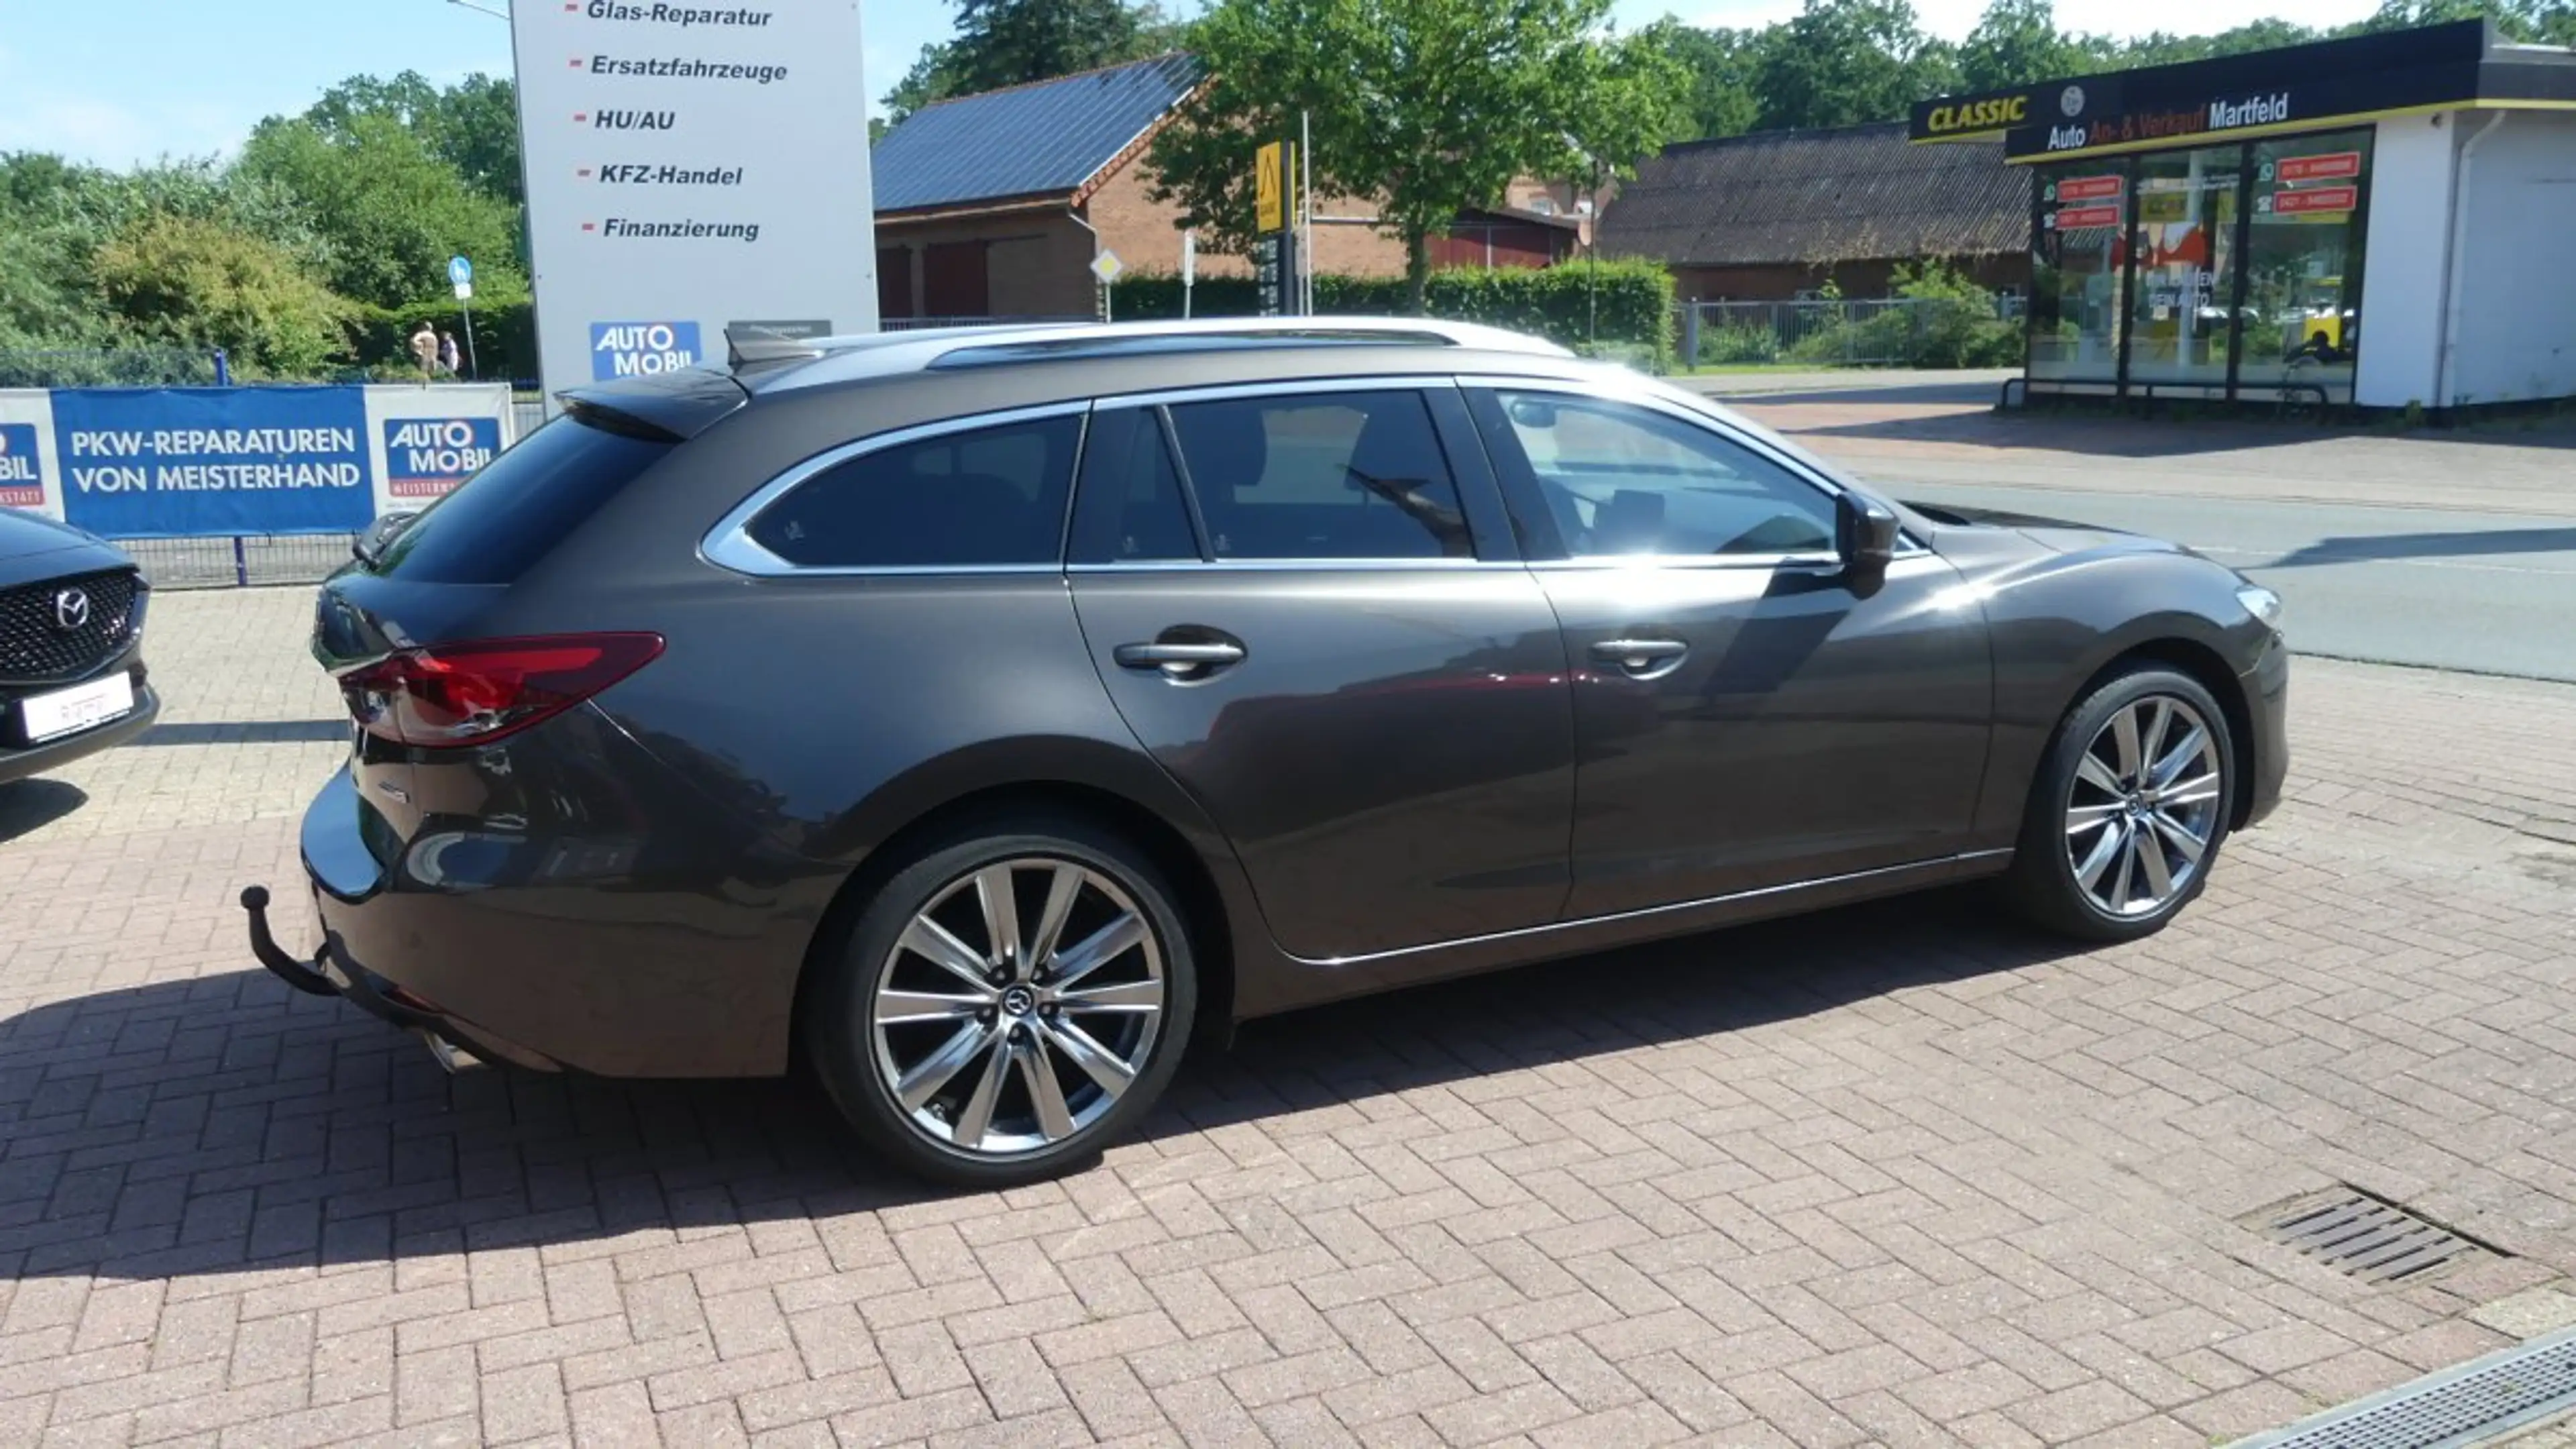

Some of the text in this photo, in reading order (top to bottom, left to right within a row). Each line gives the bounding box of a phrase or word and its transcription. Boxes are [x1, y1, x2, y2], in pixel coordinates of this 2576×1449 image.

[587, 0, 773, 27] Glas-Reparatur
[591, 55, 788, 84] Ersatzfahrzeuge
[594, 110, 676, 131] HU/AU
[1927, 95, 2028, 131] CLASSIC
[2047, 124, 2086, 150] Auto
[2121, 113, 2134, 140] &
[2139, 103, 2206, 138] Verkauf
[2208, 92, 2289, 129] Martfeld
[599, 164, 743, 185] KFZ-Handel
[603, 218, 760, 242] Finanzierung
[594, 325, 674, 352] AUTO
[71, 427, 356, 457] PKW-REPARATUREN
[389, 421, 472, 448] AUTO
[72, 463, 361, 493] VON MEISTERHAND
